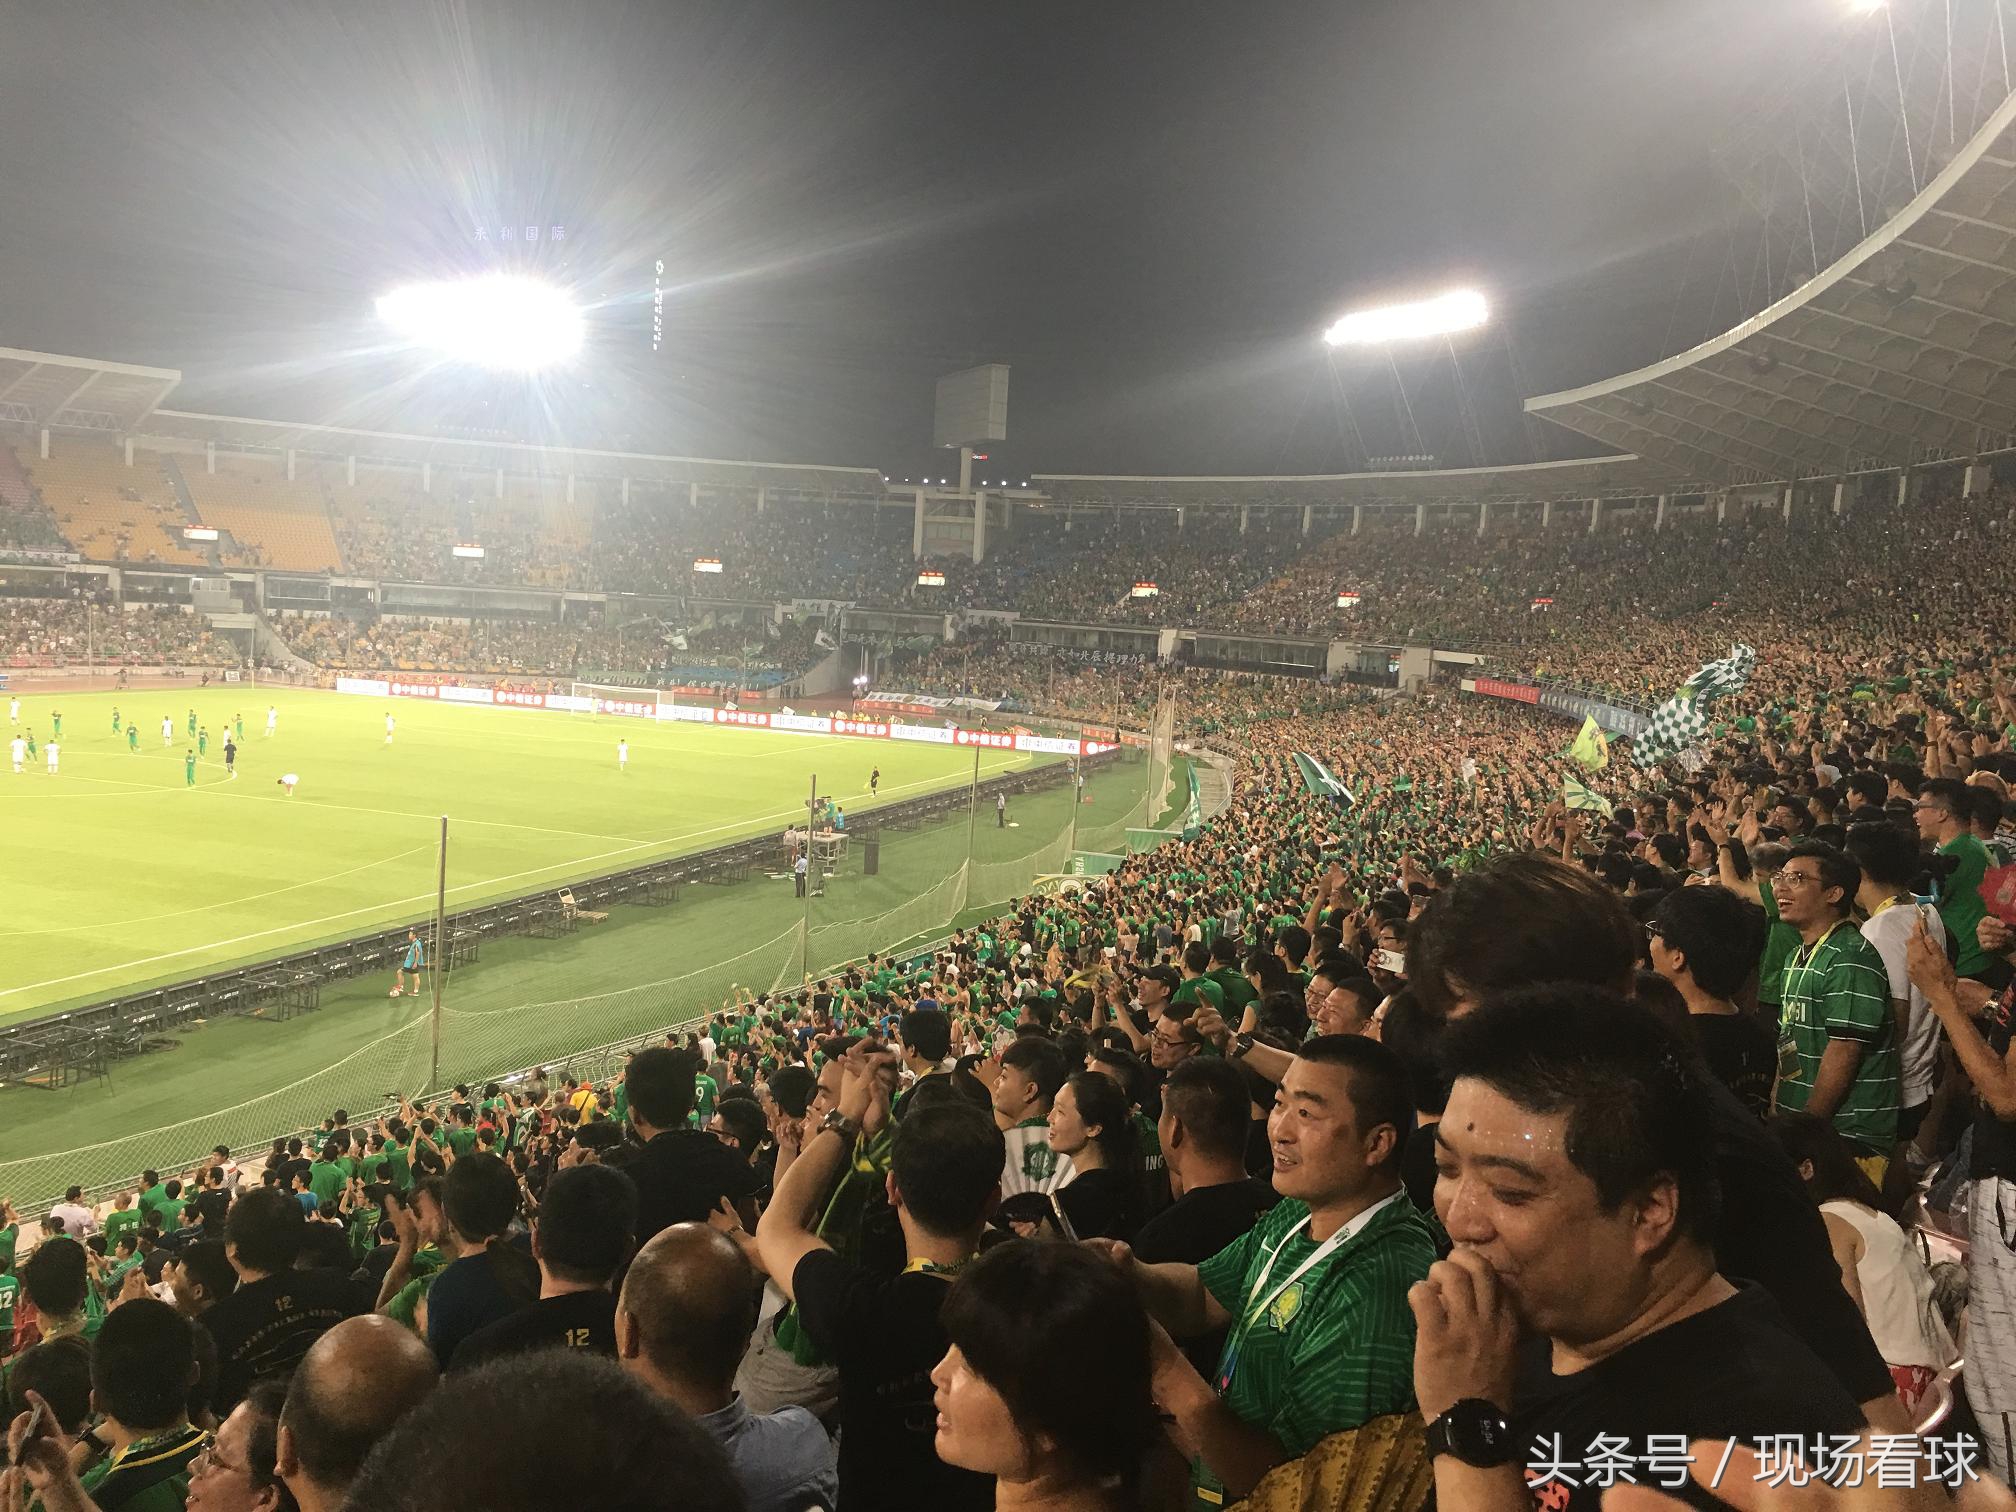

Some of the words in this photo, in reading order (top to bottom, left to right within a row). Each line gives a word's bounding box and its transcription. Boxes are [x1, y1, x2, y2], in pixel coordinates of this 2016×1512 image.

[846, 722, 887, 736] 中信证券
[969, 733, 1012, 748] 中信证券
[565, 1328, 590, 1347] 12
